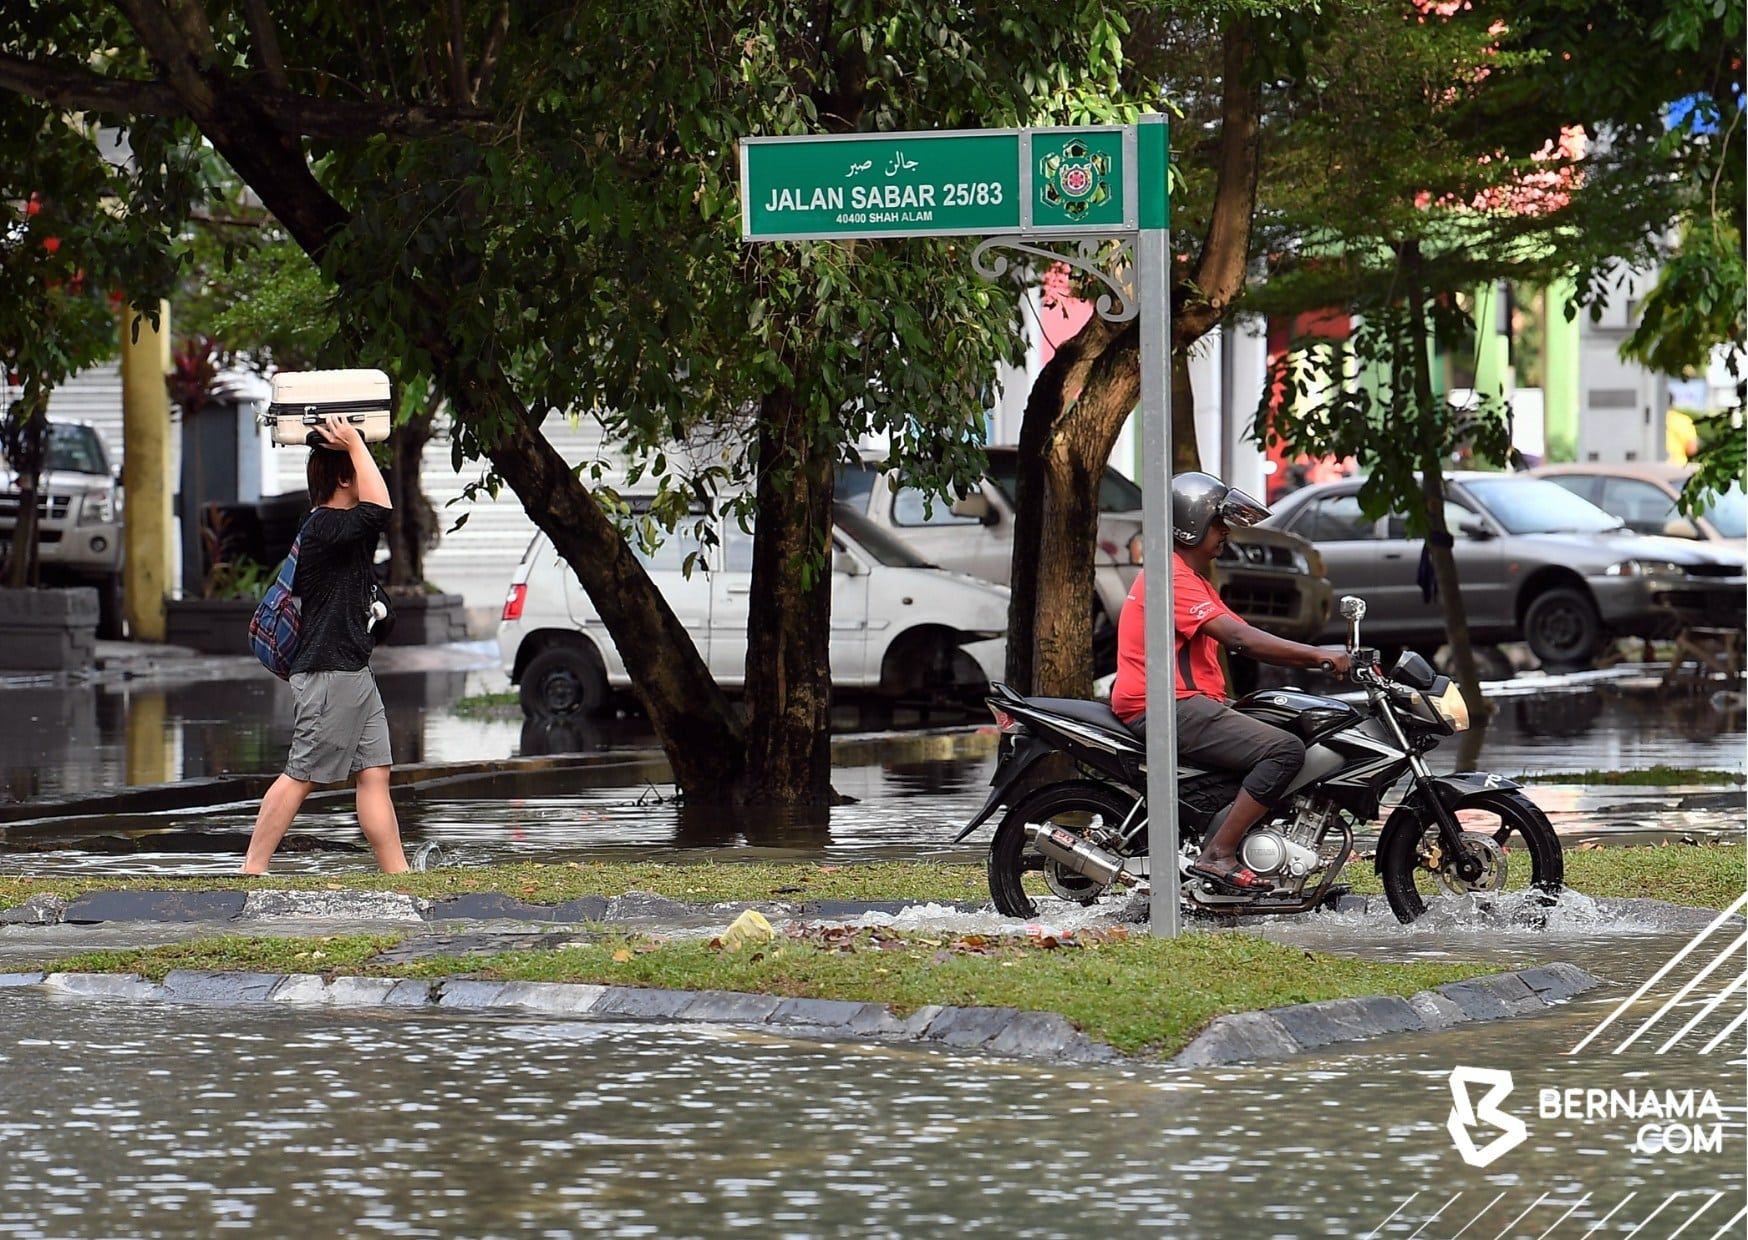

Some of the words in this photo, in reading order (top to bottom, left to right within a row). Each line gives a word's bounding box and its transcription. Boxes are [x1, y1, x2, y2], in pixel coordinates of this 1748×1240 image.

[845, 159, 873, 178] صبر
[884, 150, 919, 177] جالن
[765, 187, 844, 212] JALAN
[851, 185, 936, 209] SABAR
[942, 181, 1003, 206] 25/83
[836, 213, 867, 224] 40400
[869, 212, 899, 223] SHAH
[901, 210, 933, 222] ALAM
